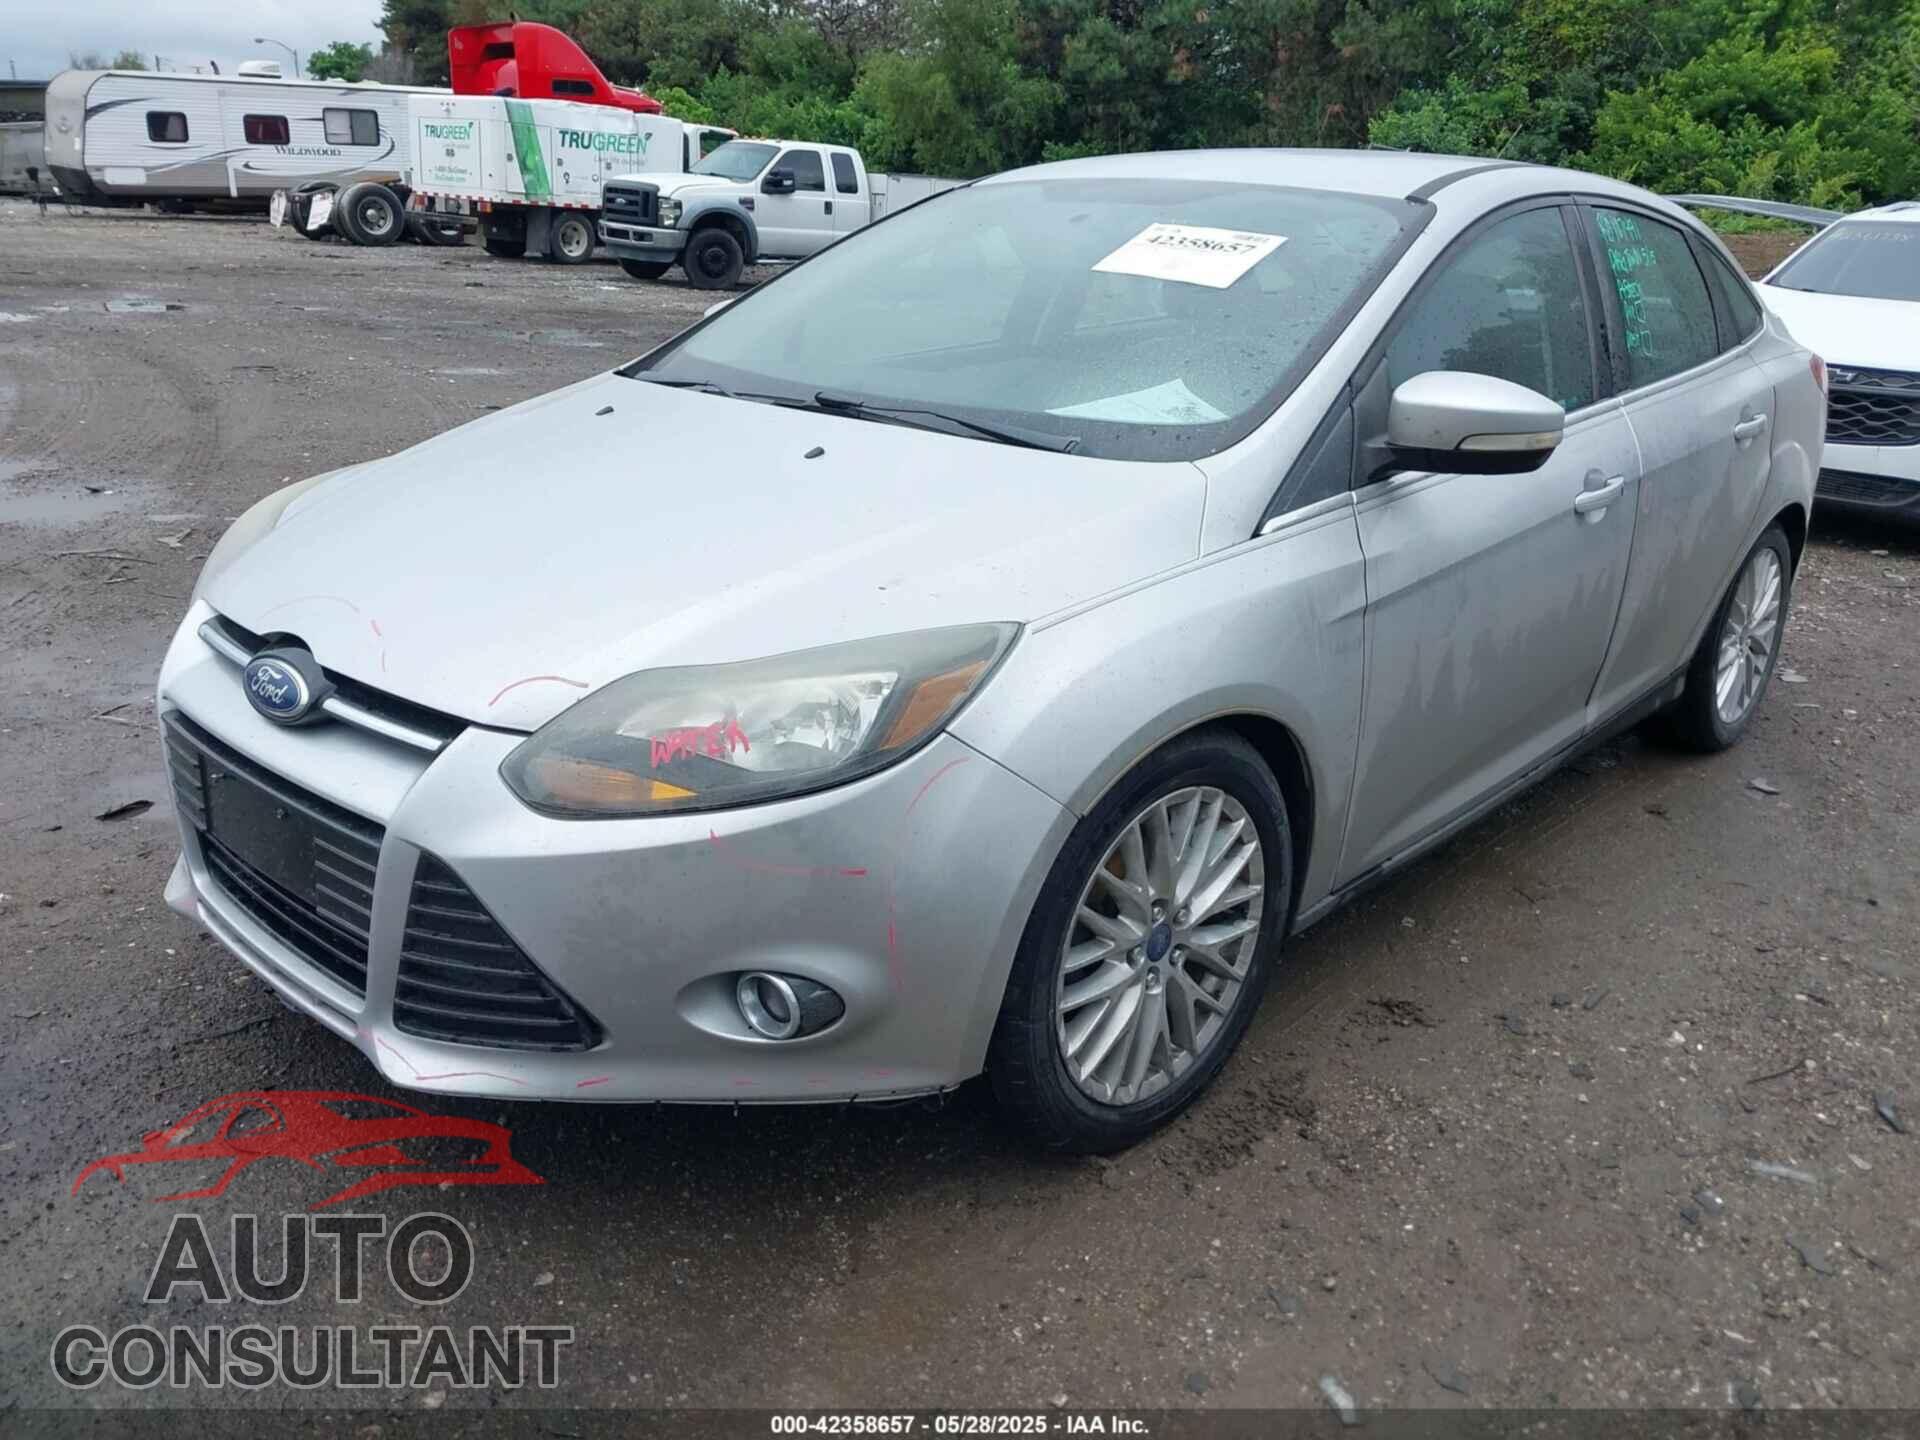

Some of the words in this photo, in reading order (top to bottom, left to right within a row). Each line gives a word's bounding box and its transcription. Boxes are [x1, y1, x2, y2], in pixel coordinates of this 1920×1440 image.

[424, 124, 471, 140] TRUGREEN
[559, 130, 648, 154] TRUGREEN
[251, 666, 289, 703] Ford
